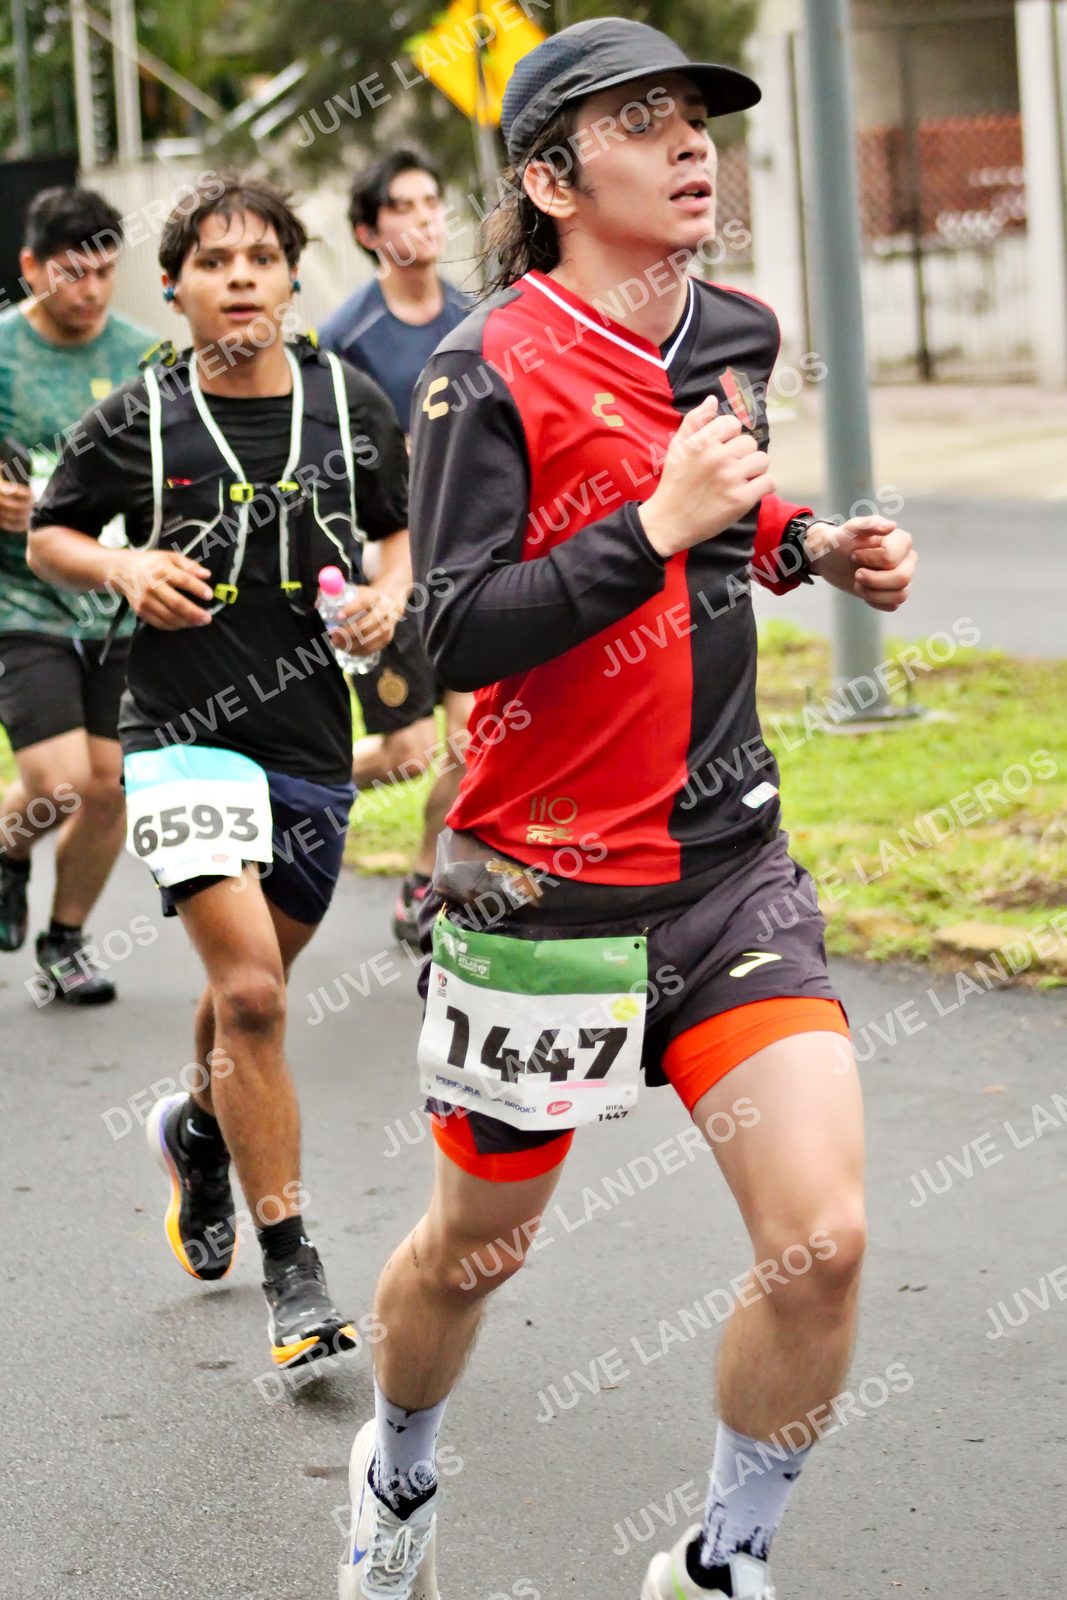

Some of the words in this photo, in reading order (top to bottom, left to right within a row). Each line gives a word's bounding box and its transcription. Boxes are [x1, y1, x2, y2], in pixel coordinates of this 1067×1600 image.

[133, 804, 259, 857] 6593
[446, 1005, 628, 1084] 1447
[504, 1101, 537, 1114] BROOKS
[598, 1110, 629, 1122] 1447
